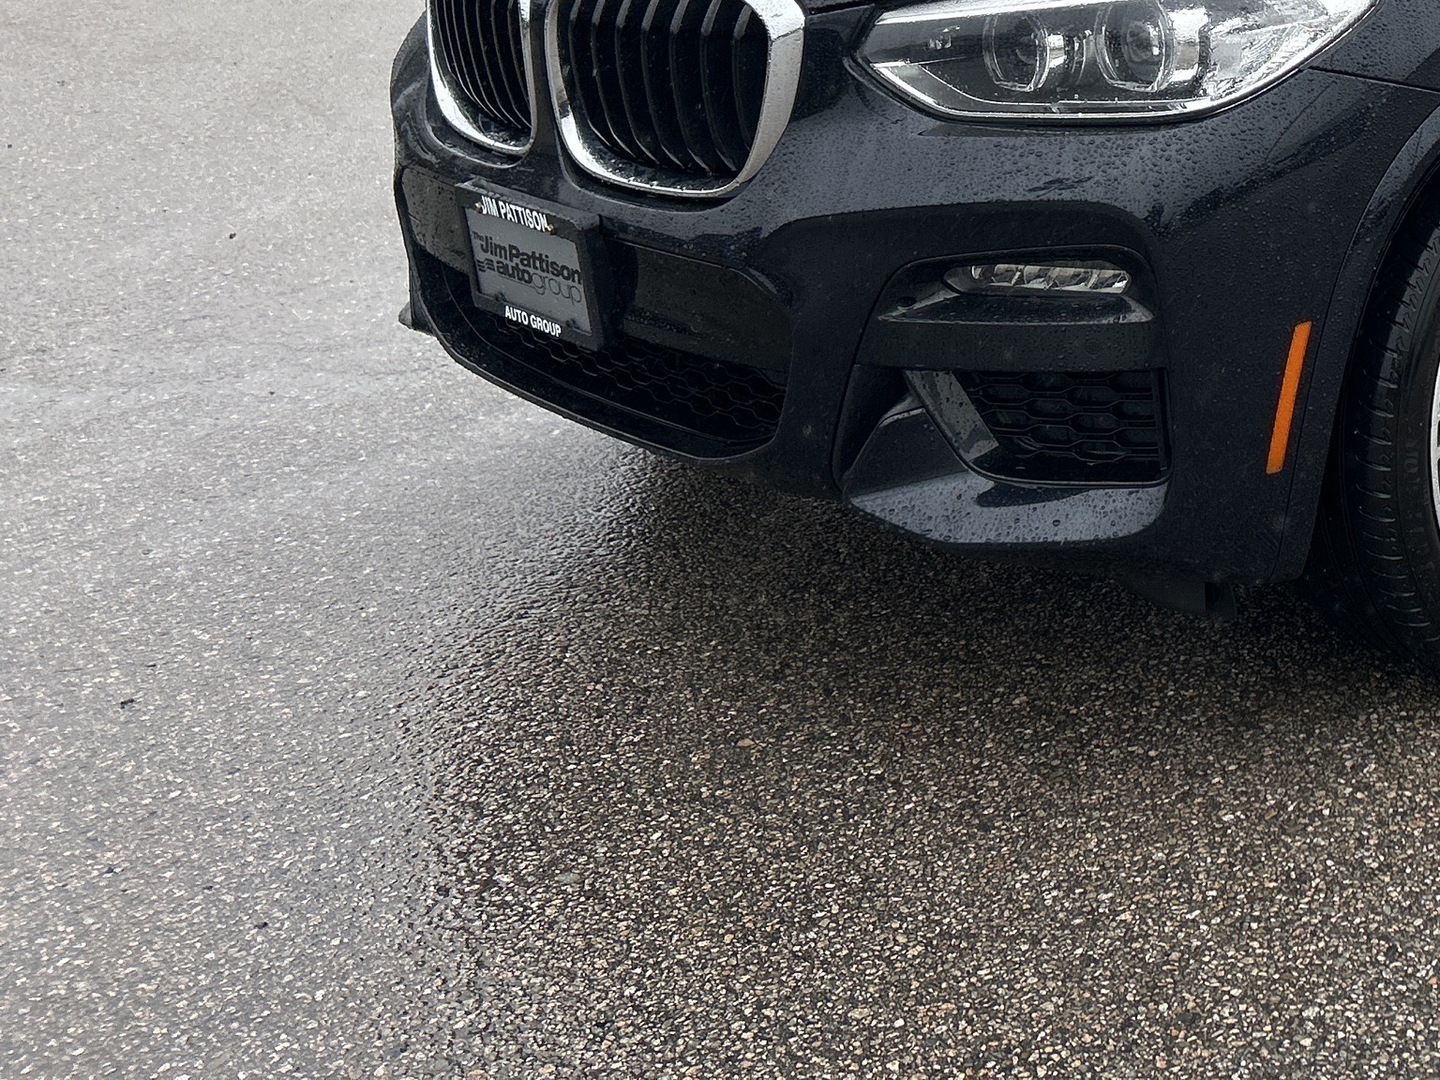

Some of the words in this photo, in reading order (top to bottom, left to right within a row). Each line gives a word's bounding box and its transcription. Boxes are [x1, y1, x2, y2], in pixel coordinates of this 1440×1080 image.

[481, 195, 500, 218] JIM
[500, 201, 550, 232] PATTISON
[504, 305, 529, 325] AUTO
[530, 315, 562, 337] GROUP
